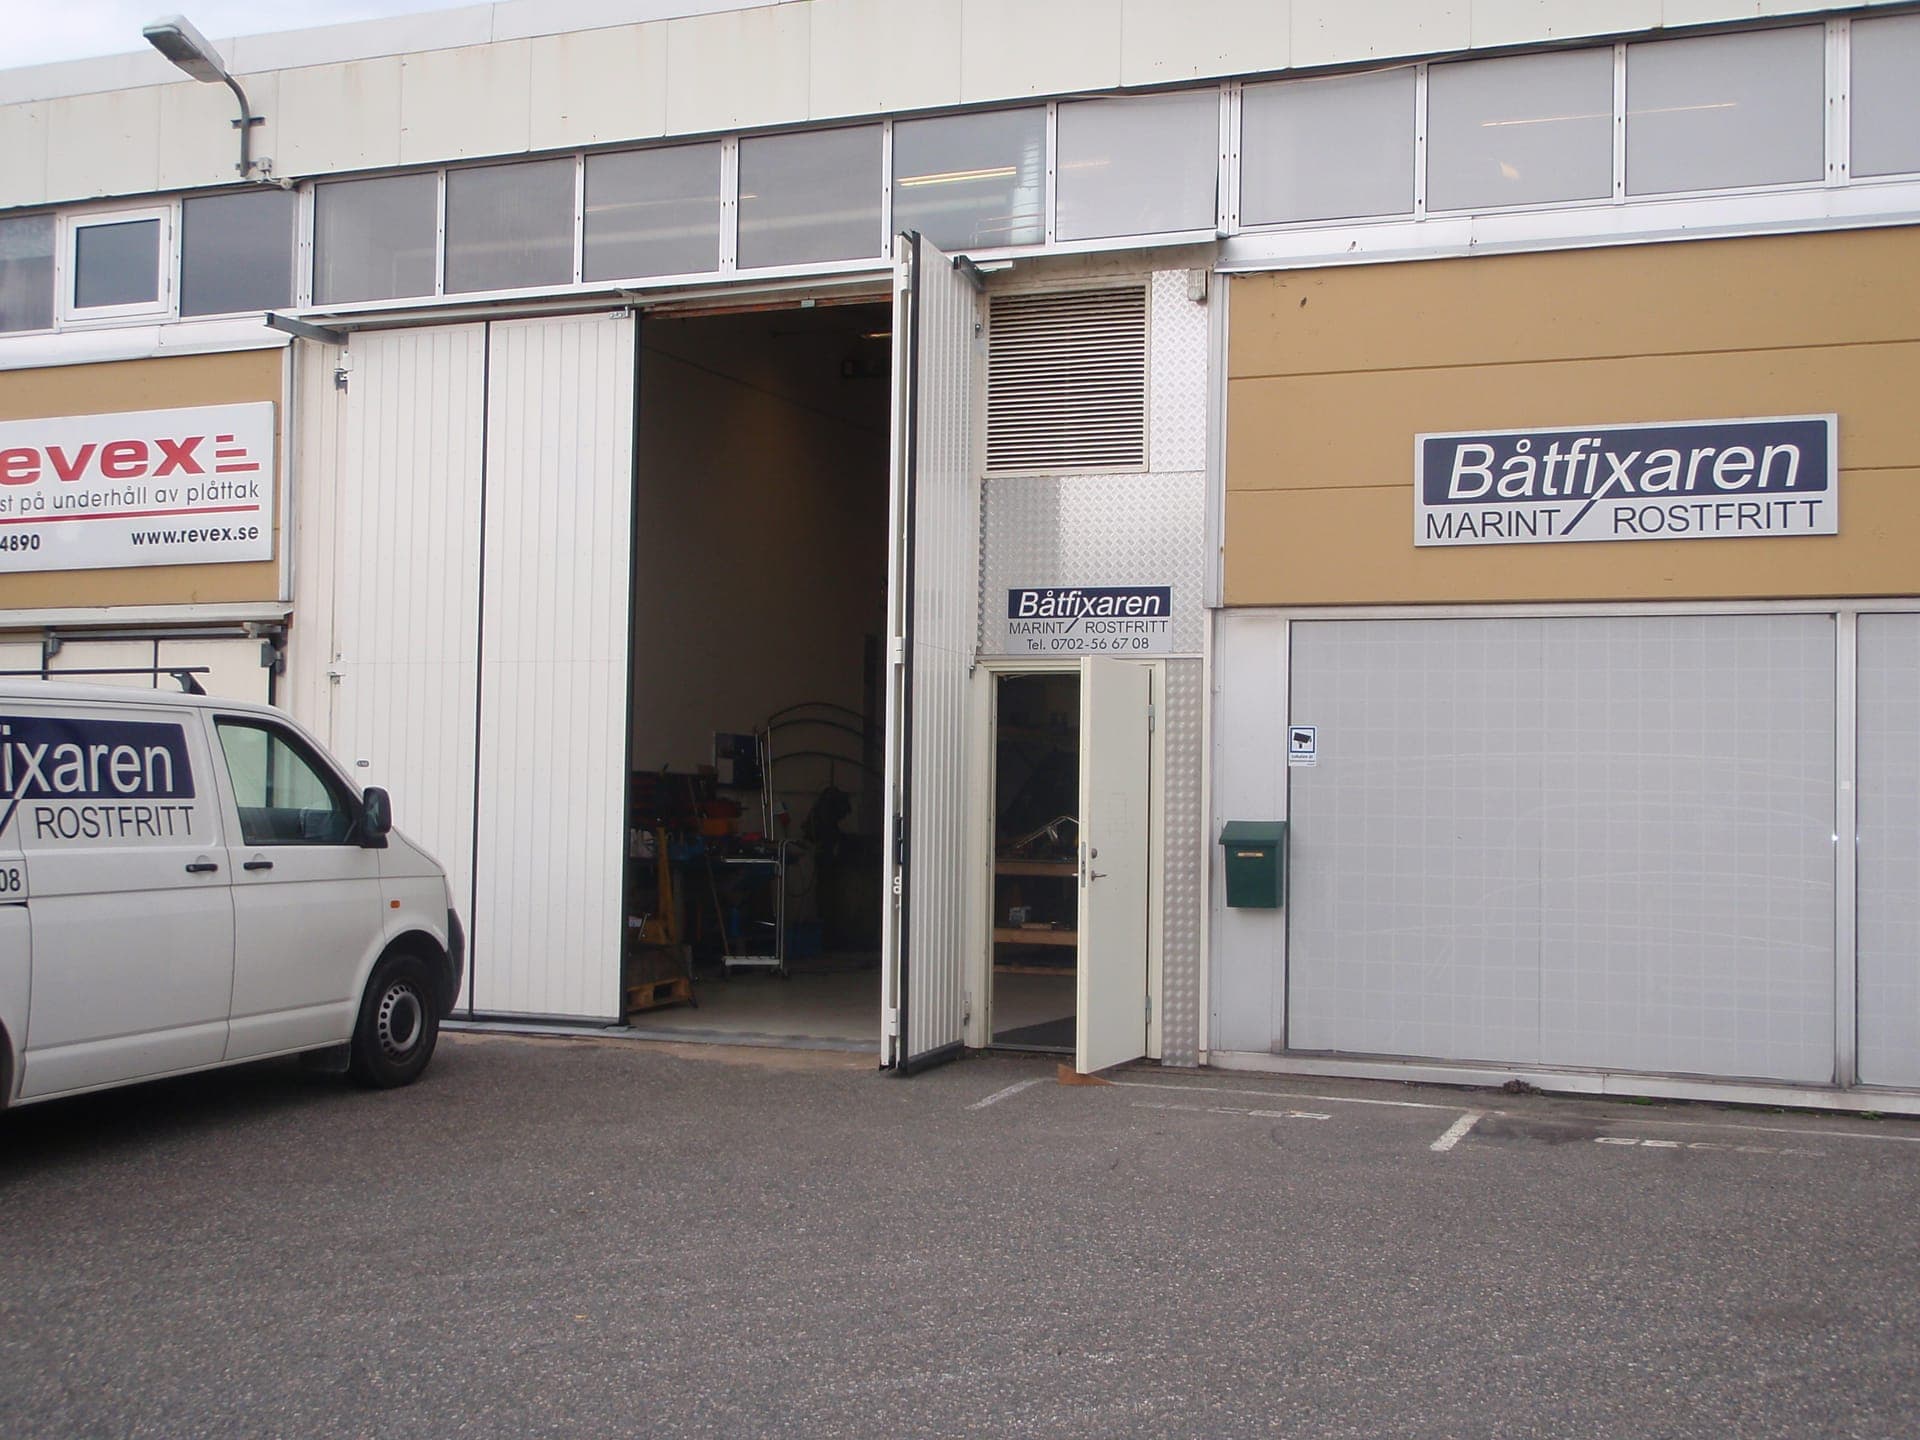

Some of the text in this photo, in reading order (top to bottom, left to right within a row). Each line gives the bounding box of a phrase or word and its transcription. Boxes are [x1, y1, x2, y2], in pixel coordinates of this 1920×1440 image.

[0, 436, 206, 486] evex
[1448, 438, 1800, 502] Båtfixaren
[20, 490, 45, 515] på
[53, 486, 147, 510] underhåll
[155, 487, 179, 504] av
[186, 480, 260, 507] plåttak
[1426, 500, 1823, 539] MARINT ROSTFRITT
[0, 526, 259, 551] 4890 www.revex.se
[1018, 590, 1161, 618] Båtfixaren
[1009, 620, 1169, 635] MARINT ROSTFRITT
[1027, 637, 1150, 650] Tel. 0702-56 67 08
[0, 725, 174, 799] ixaren
[34, 806, 195, 839] ROSTFRITT
